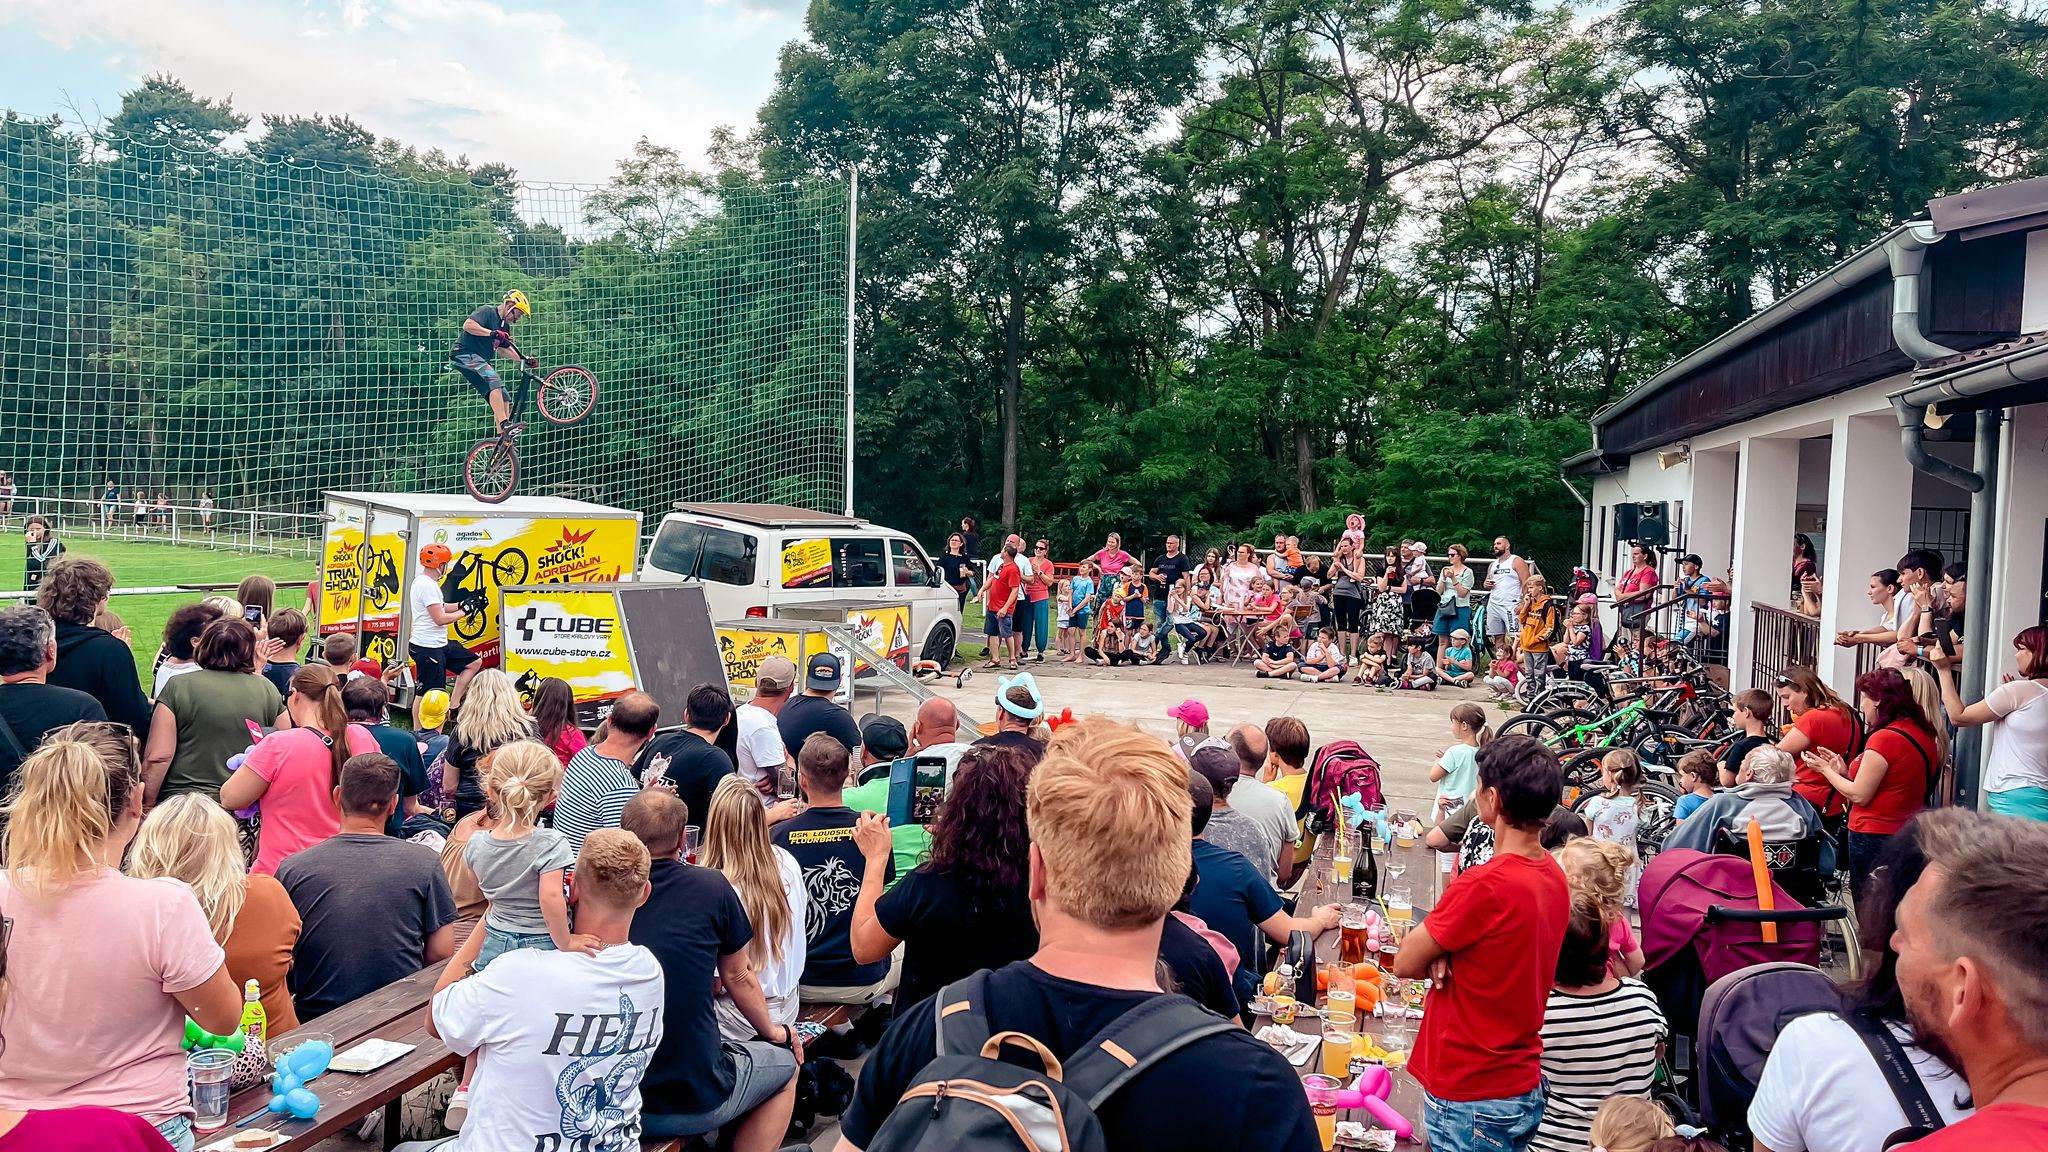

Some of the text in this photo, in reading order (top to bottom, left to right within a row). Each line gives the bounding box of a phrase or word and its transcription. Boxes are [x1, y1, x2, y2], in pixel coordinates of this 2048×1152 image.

[537, 545, 585, 570] SHOCK!
[326, 567, 360, 580] TRIAL
[534, 555, 601, 581] ADRENALIN
[325, 579, 360, 591] SHOW
[539, 617, 615, 633] CUBE
[475, 645, 500, 659] Marti
[515, 646, 612, 658] www.cube-store.cz
[741, 645, 764, 655] SHOCK!
[725, 659, 760, 673] TRIAL
[541, 1007, 660, 1056] HELL
